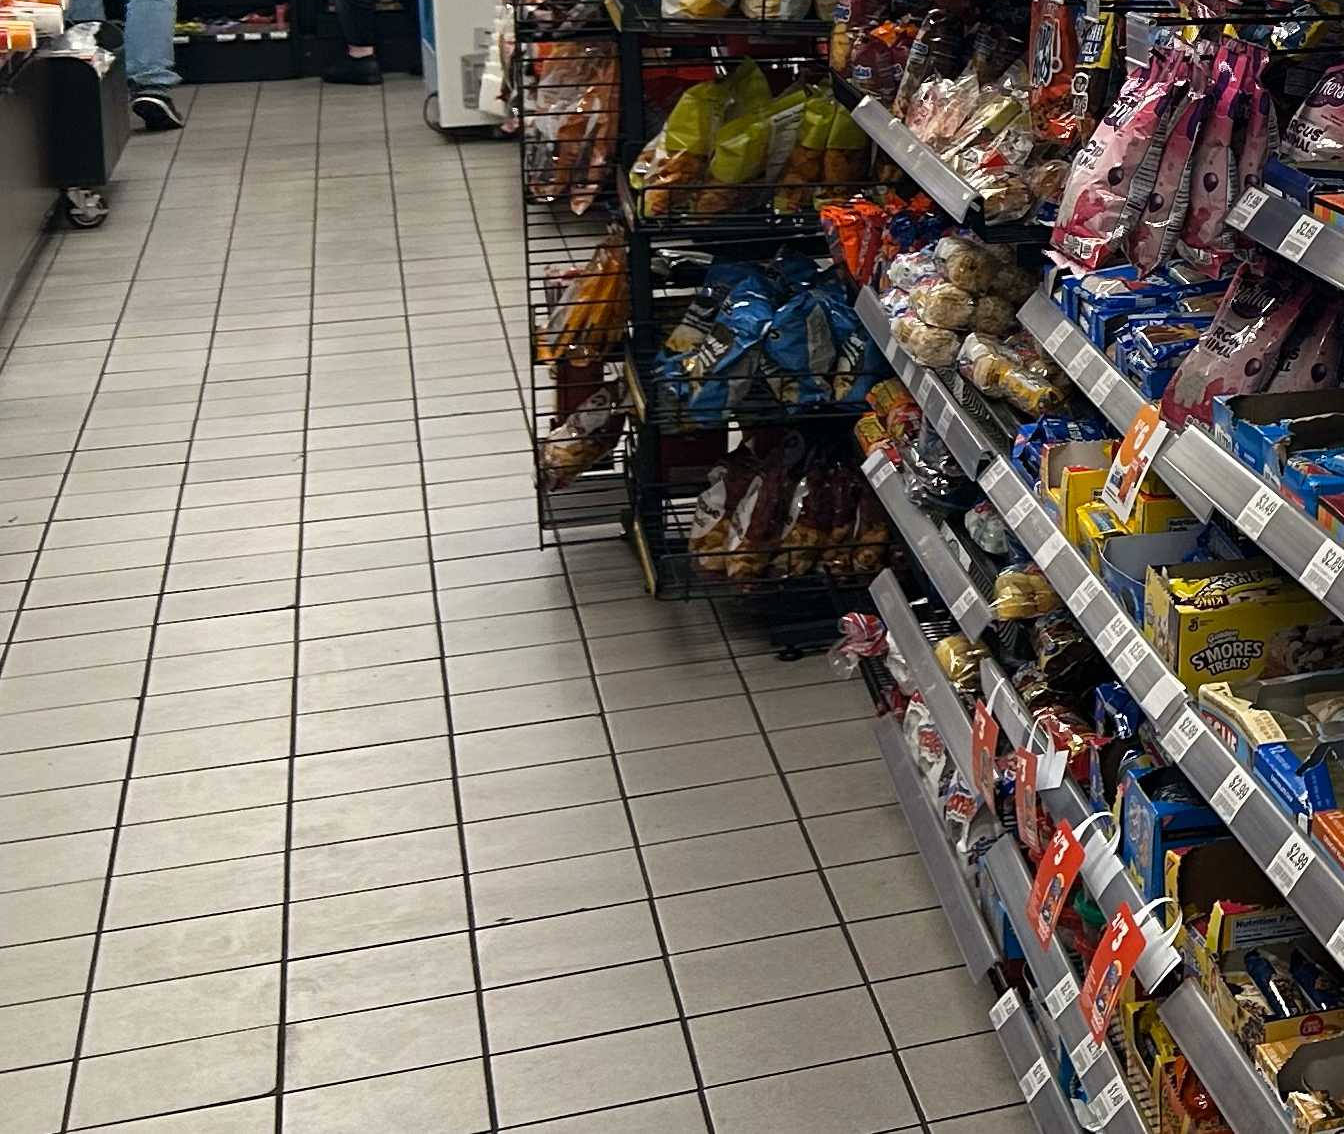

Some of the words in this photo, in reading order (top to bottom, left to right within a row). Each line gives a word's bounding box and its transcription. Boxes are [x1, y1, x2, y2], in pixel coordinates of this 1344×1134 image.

[1255, 492, 1278, 516] $3.49
[1191, 640, 1264, 669] S'MORES
[1208, 653, 1250, 674] TREATS
[1229, 775, 1250, 801] $2.99
[1286, 841, 1309, 869] $2.99
